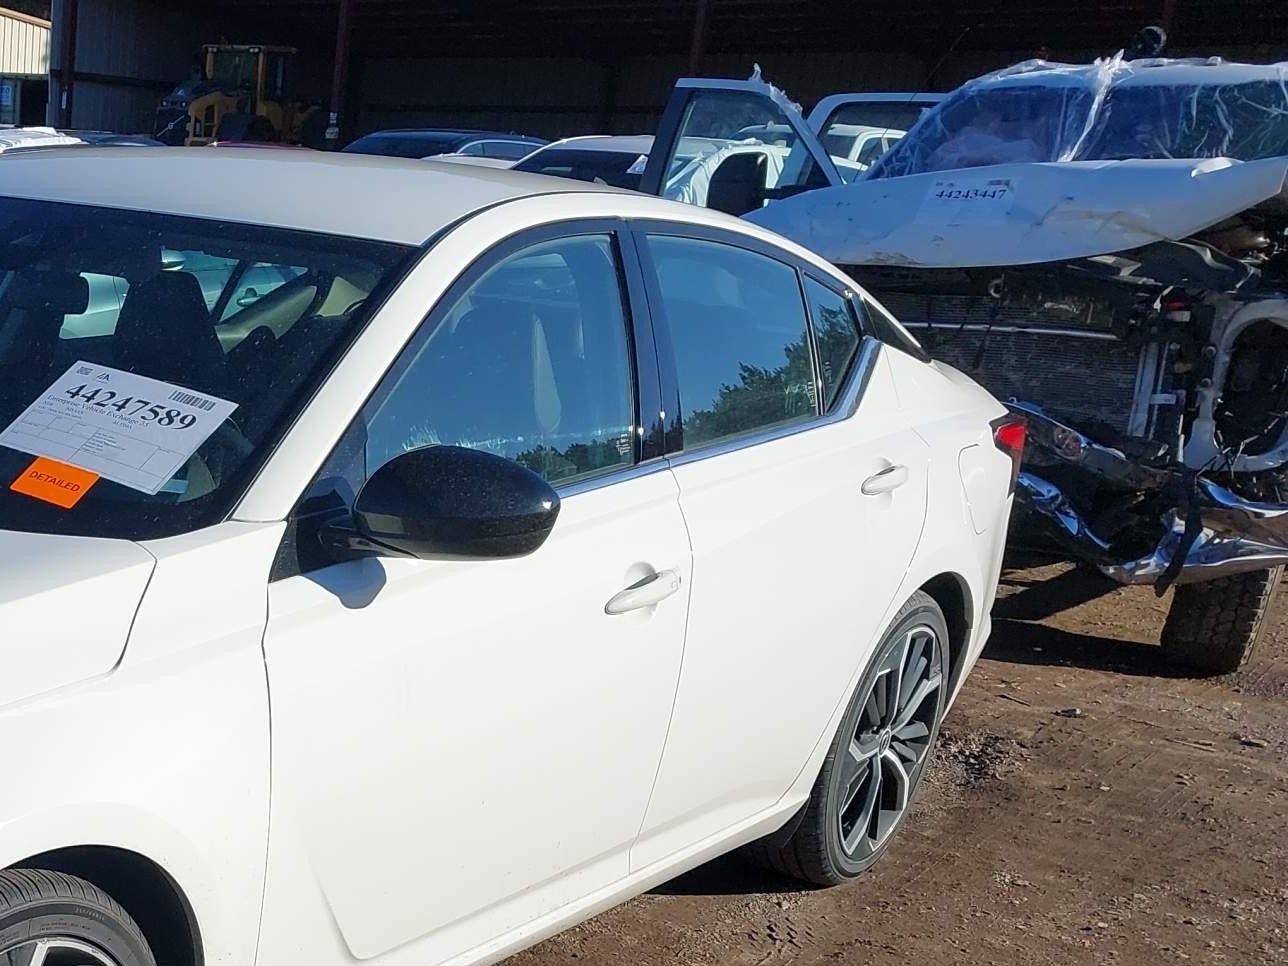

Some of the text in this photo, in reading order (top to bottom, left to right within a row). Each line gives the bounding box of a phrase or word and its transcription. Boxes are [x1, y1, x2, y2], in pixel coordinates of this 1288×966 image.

[935, 188, 1008, 200] 44243447
[64, 383, 198, 431] 44247589
[29, 470, 81, 492] DETAILED
